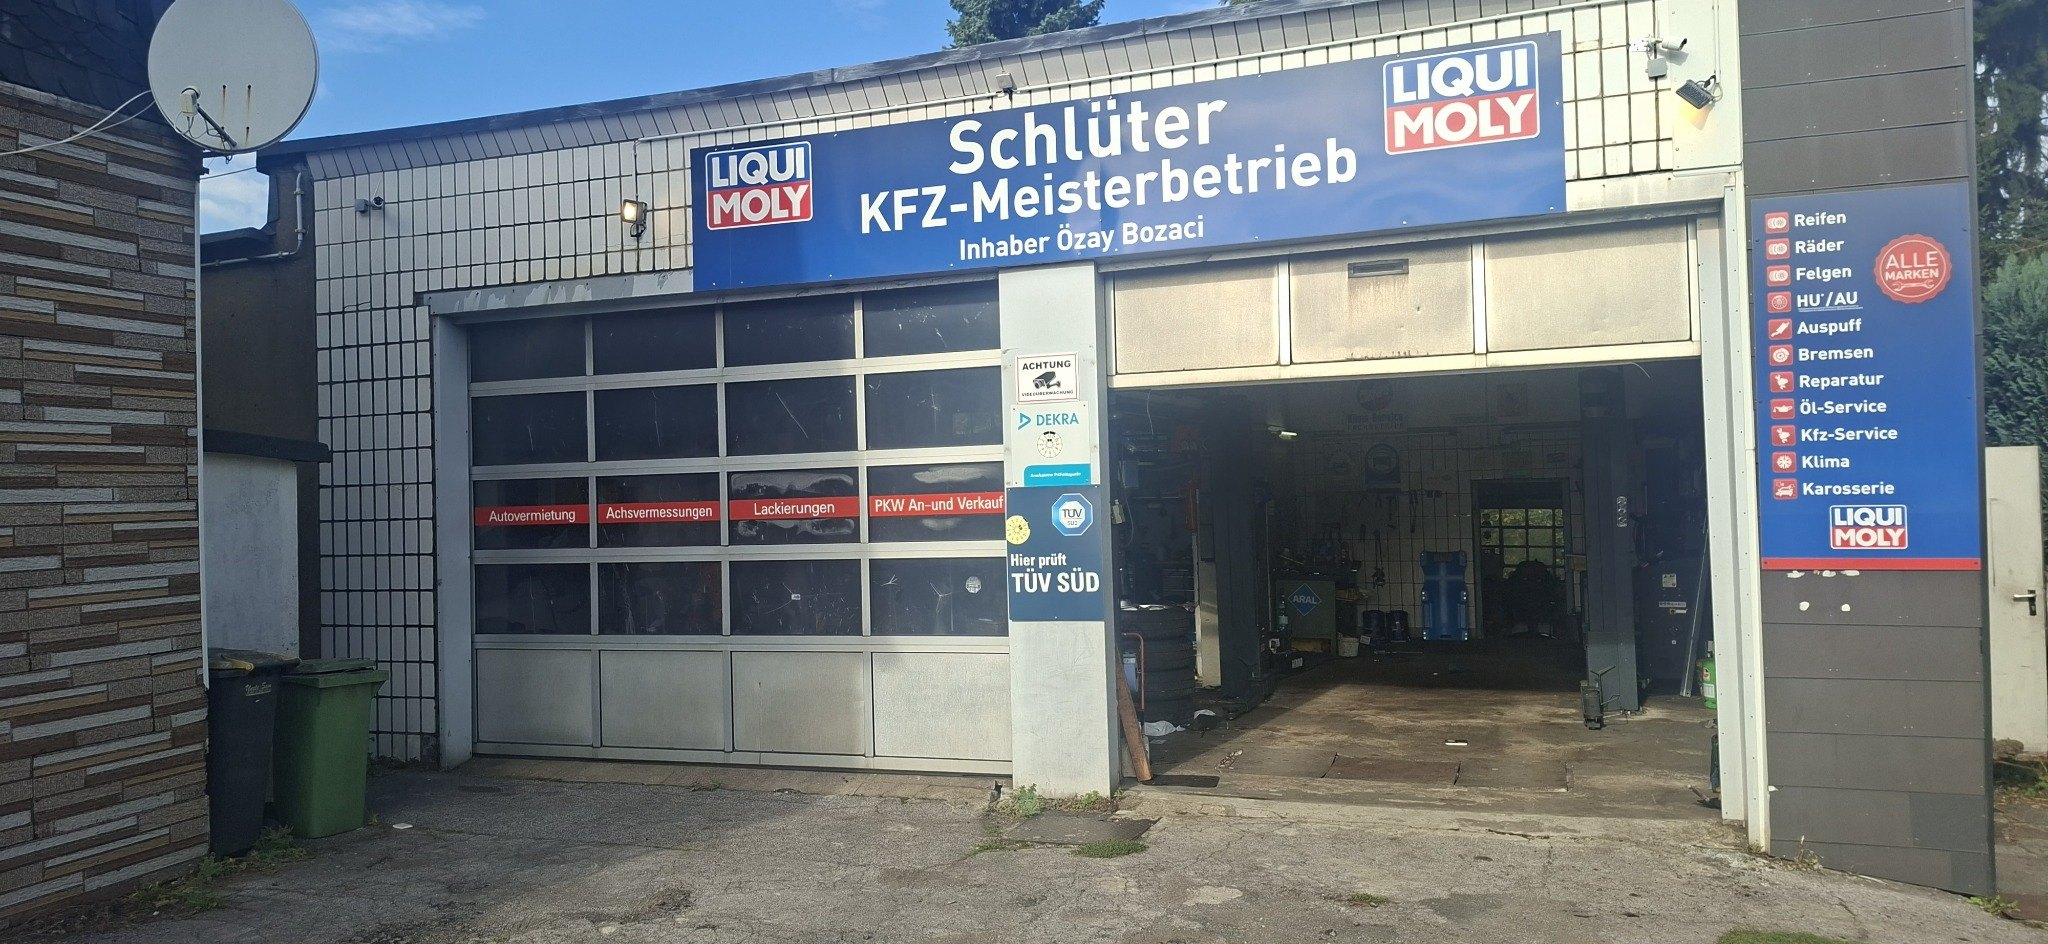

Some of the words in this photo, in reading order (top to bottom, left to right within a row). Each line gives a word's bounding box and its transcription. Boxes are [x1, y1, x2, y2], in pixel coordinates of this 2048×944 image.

[1393, 48, 1528, 103] LIQUI
[1394, 93, 1534, 148] MOLY
[948, 95, 1227, 175] Schlüter
[712, 147, 804, 188] LIQUI
[860, 137, 1358, 235] KFZ-Meisterbetrieb
[713, 184, 809, 224] MOLY
[1794, 212, 1847, 227] Reifen
[959, 233, 1050, 261] Inhaber
[1057, 222, 1115, 253] Özay
[1122, 214, 1206, 245] Bozaci
[1795, 239, 1845, 254] Räder
[1885, 250, 1939, 270] ALLE
[1796, 267, 1852, 283] Felgen
[1885, 268, 1939, 281] MARKEN
[1797, 318, 1862, 336] Auspuff
[1798, 347, 1874, 362] Bremsen
[1022, 360, 1072, 371] ACHTUNG
[1799, 373, 1885, 390] Reparatur
[1800, 399, 1887, 415] Öl-Service
[1036, 412, 1080, 426] DEKRA
[1801, 426, 1898, 442] Kfz-Service
[1802, 455, 1850, 469] Klima
[1802, 481, 1895, 496] Karosserie
[754, 501, 836, 518] Lackierungen
[874, 498, 906, 513] PKW
[957, 495, 1004, 511] Verkauf
[488, 508, 577, 524] Autovermietung
[605, 506, 714, 521] Achsvermessungen
[1834, 507, 1903, 527] LIQUI
[1835, 528, 1905, 547] MOLY
[1010, 553, 1036, 567] Hier
[1038, 552, 1067, 569] prüft
[1011, 567, 1052, 593] TÜV
[1057, 567, 1100, 593] SÜD
[1292, 594, 1317, 605] ARAL
